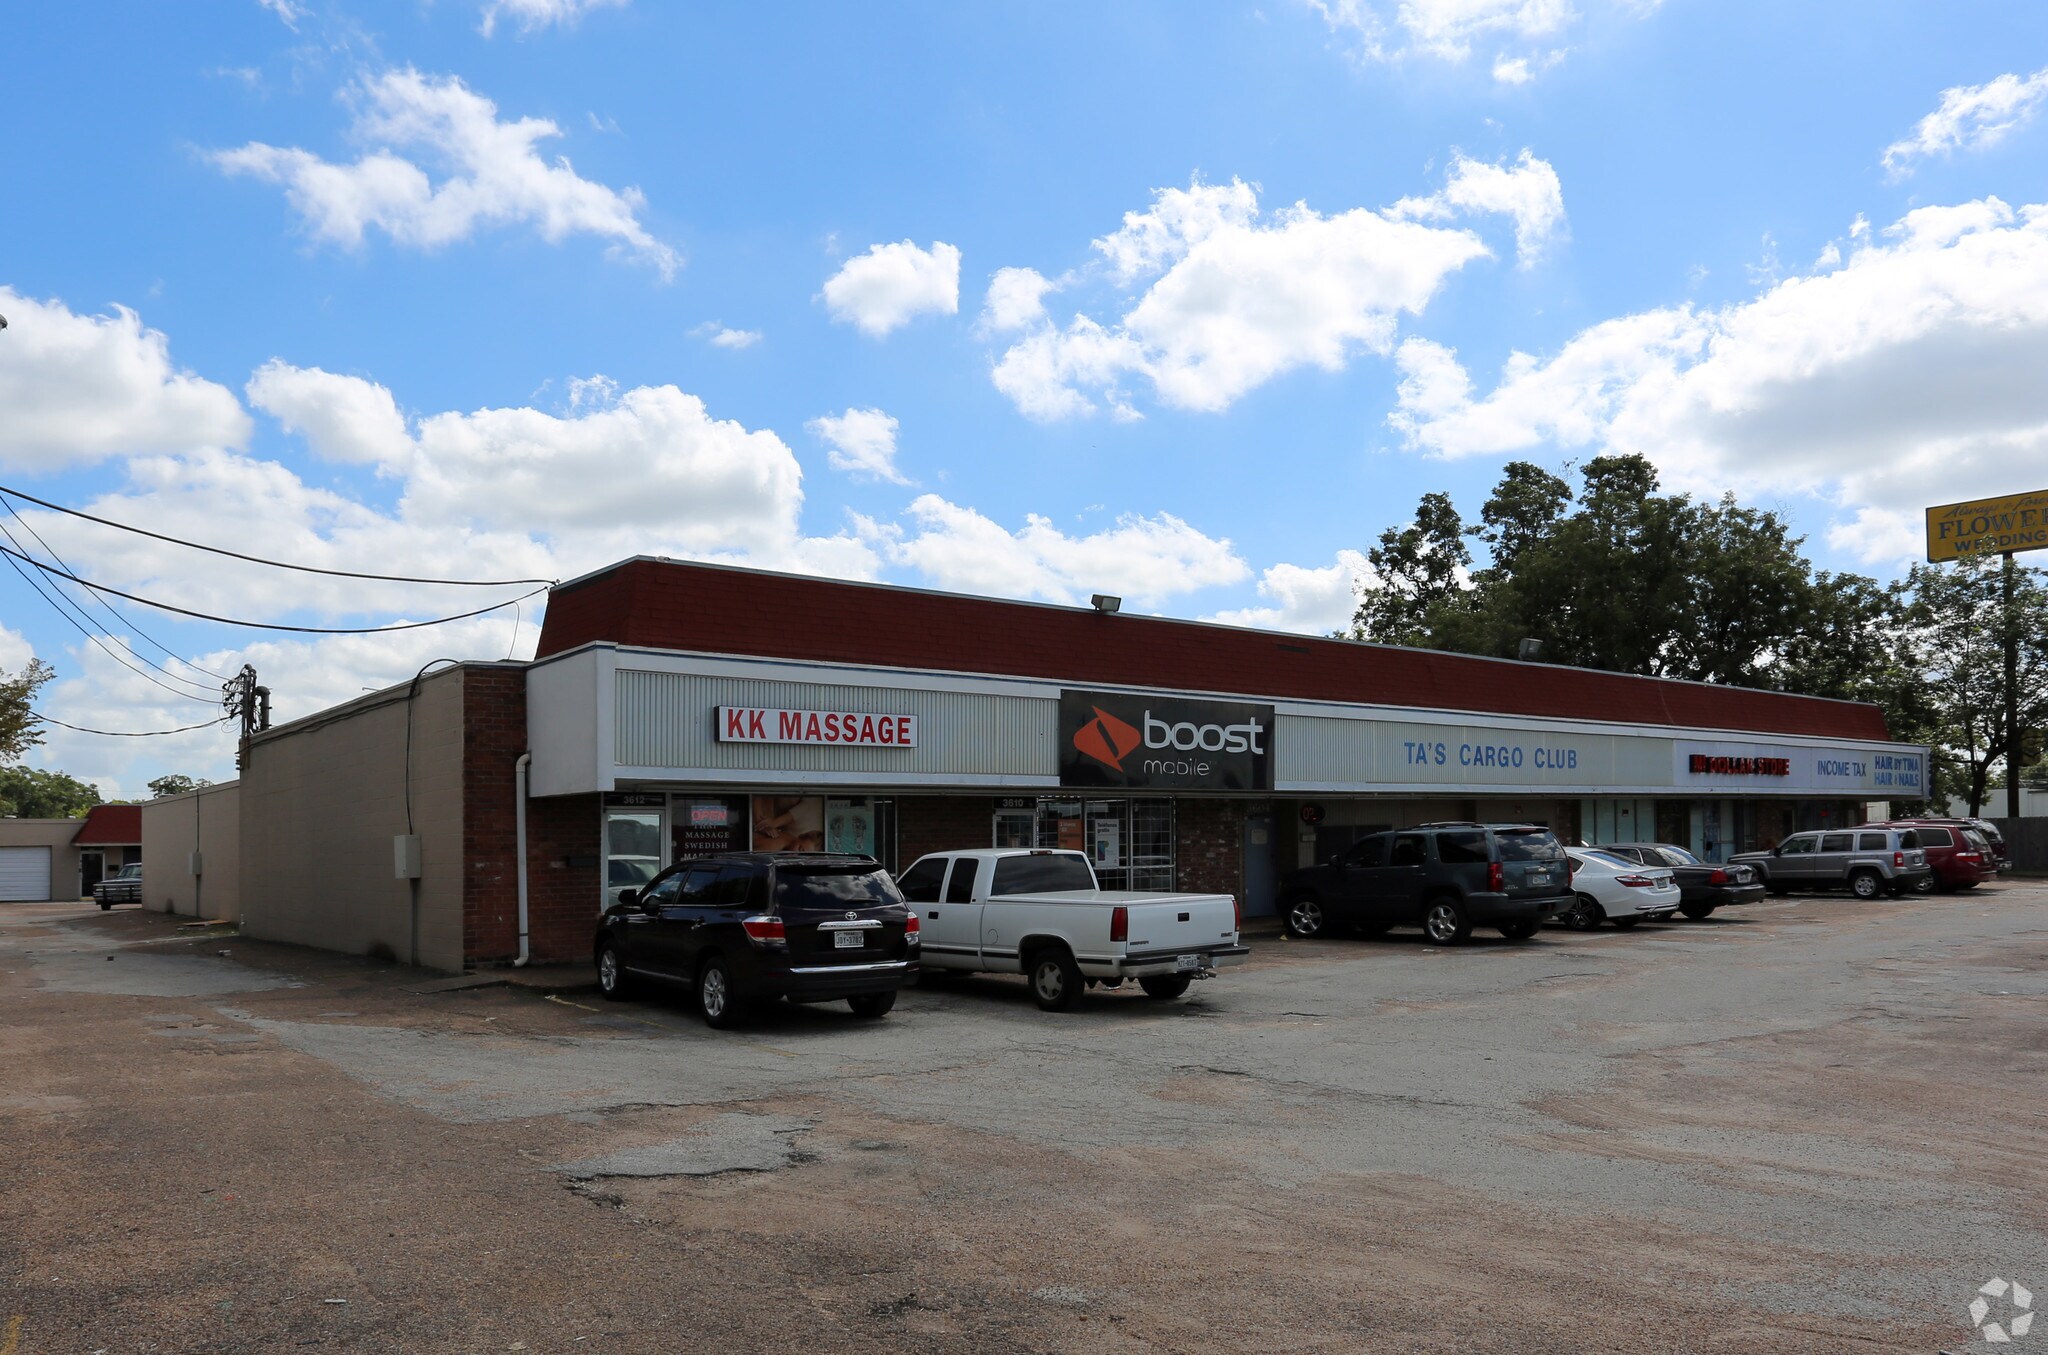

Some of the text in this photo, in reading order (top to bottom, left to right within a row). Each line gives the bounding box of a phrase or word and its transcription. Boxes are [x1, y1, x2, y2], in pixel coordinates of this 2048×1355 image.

[728, 709, 911, 744] KK MASSAGE
[1143, 709, 1264, 755] boost
[1404, 742, 1577, 768] TA'S CARGO CLUB
[1874, 755, 1893, 770] HAIR
[1902, 757, 1920, 772] TINA
[1143, 757, 1210, 776] mobile
[1756, 757, 1790, 775] STORE
[1817, 760, 1867, 777] INCOME TAX
[1874, 772, 1893, 785] HAIR
[1898, 772, 1919, 786] NAILS
[623, 795, 646, 805] 3612
[1002, 798, 1024, 807] 3610
[691, 810, 727, 821] OPEN
[685, 831, 730, 839] MASSAGE
